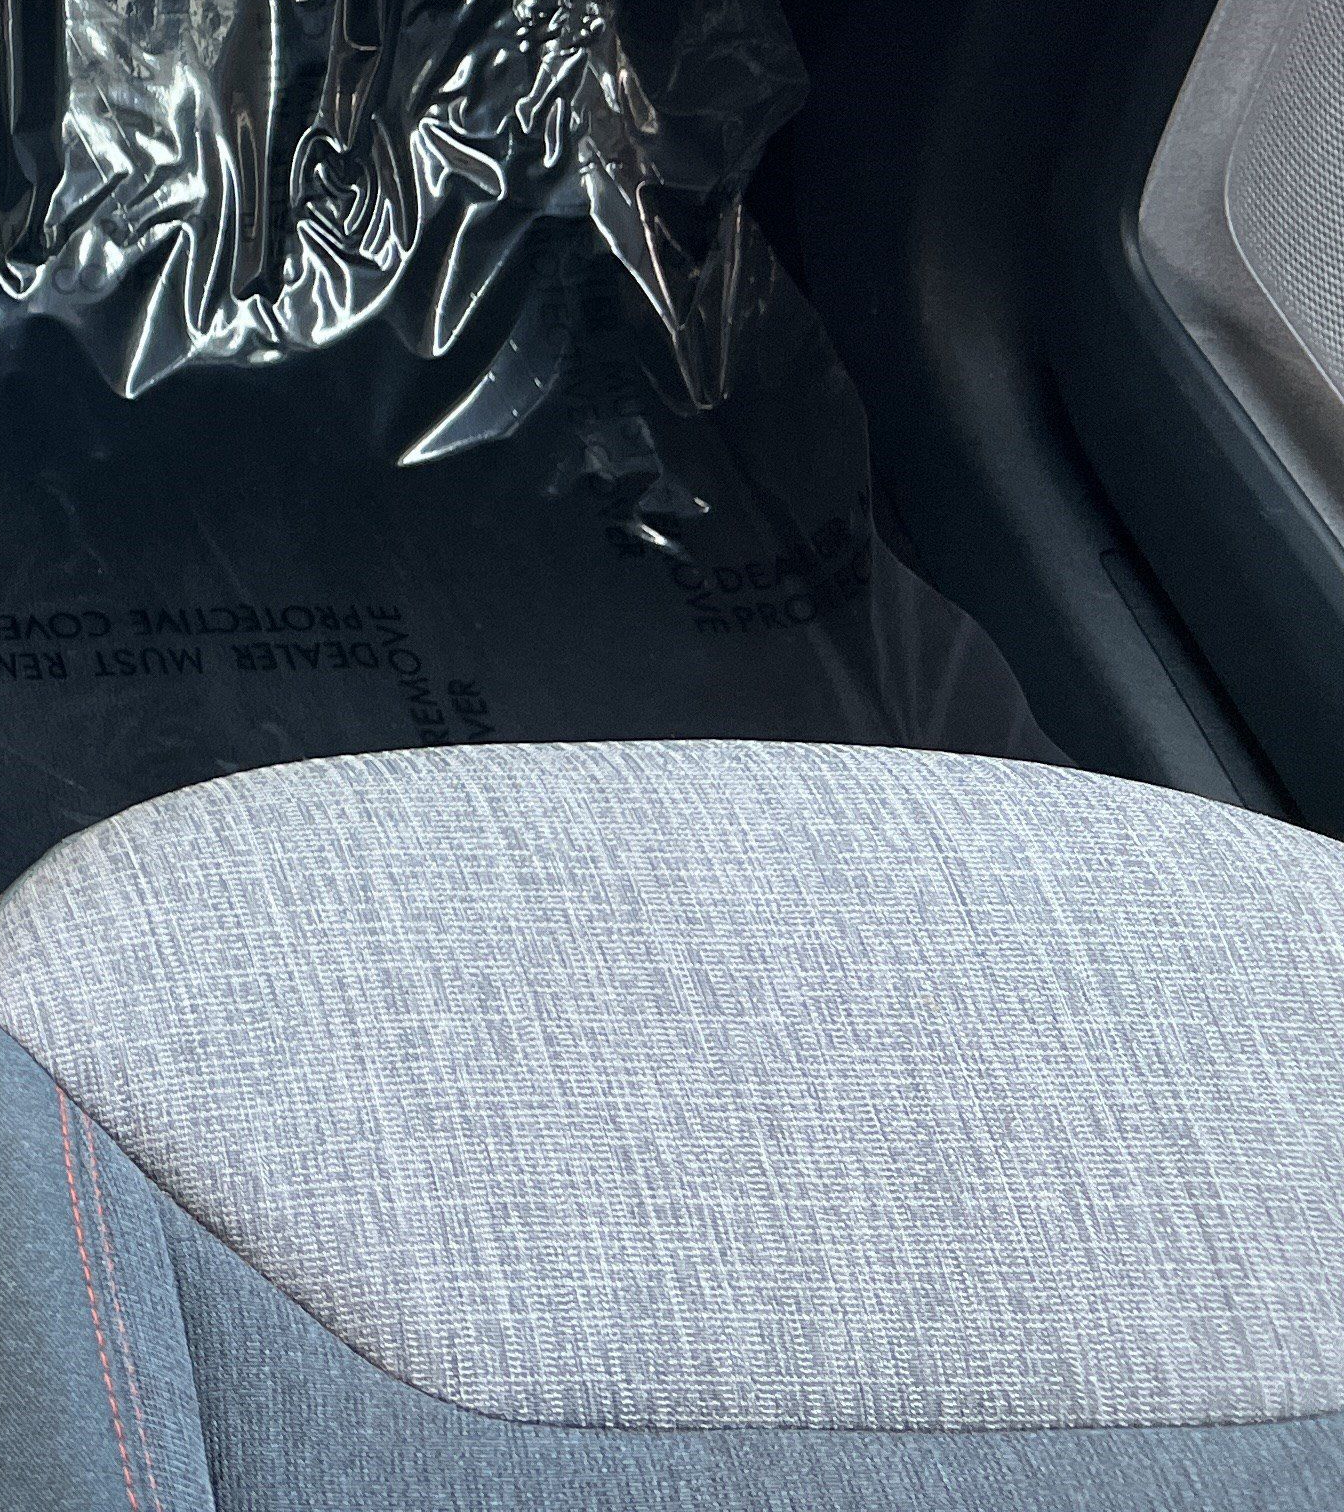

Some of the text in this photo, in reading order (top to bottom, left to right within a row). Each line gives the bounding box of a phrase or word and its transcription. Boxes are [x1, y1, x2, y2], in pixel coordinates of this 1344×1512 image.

[128, 603, 364, 636] PROTECTIVE
[94, 646, 204, 678] MUST
[230, 640, 380, 672] DEALER
